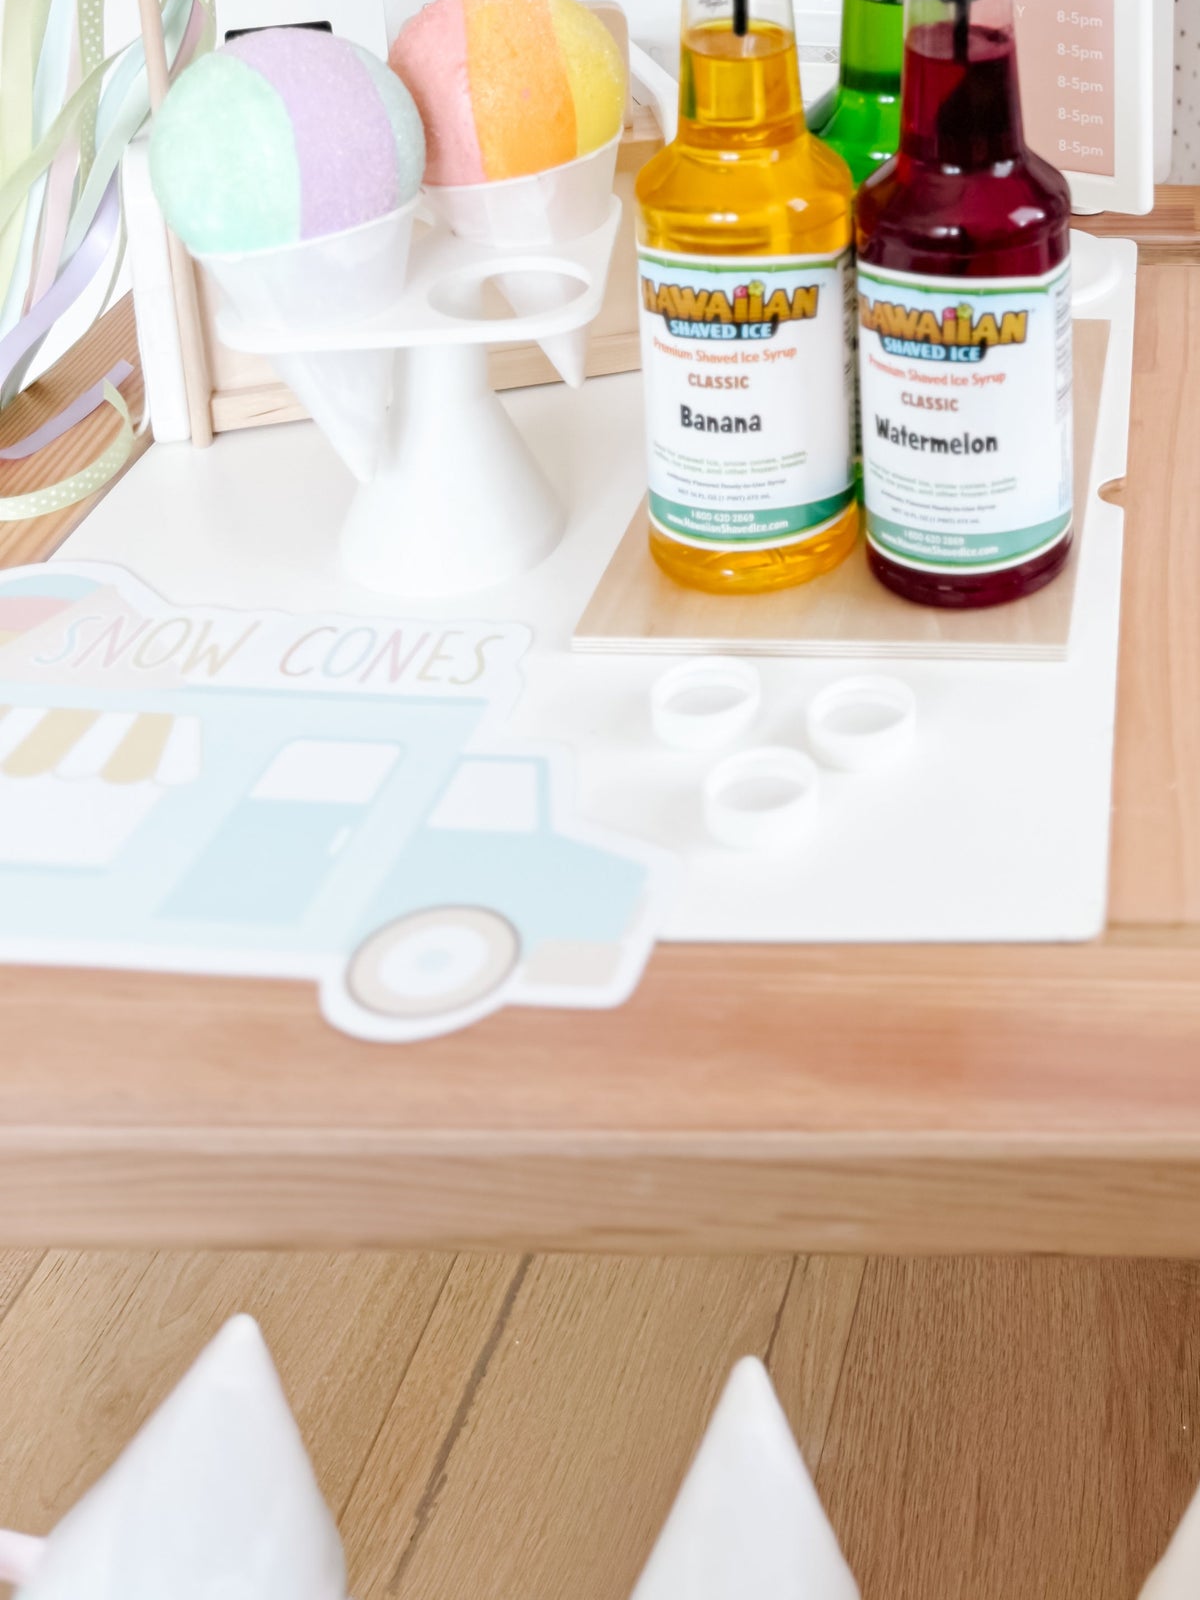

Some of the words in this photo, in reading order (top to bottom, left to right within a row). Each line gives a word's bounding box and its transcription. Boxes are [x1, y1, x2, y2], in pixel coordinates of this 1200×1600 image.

[1056, 11, 1103, 27] 8-5pm
[1056, 44, 1103, 60] 8-5pm
[1056, 76, 1103, 92] 8-5pm
[1056, 108, 1103, 125] 8-5pm
[1056, 140, 1103, 157] 8-5pm
[641, 275, 820, 324] HAWAIIAN
[671, 320, 737, 339] SHAVED
[742, 323, 772, 339] ICE
[653, 336, 692, 360] Premium
[697, 351, 737, 363] Shaved
[742, 351, 759, 363] Ice
[763, 346, 797, 364] Syrup
[884, 337, 946, 360] SHAVED
[950, 346, 980, 361] ICE
[688, 373, 749, 389] CLASSIC
[909, 368, 947, 386] Shaved
[951, 374, 968, 386] Ice
[972, 373, 1006, 388] Syrup
[901, 391, 959, 412] CLASSIC
[680, 404, 762, 433] Banana
[875, 413, 998, 455] Watermelon
[33, 613, 261, 676] SNOW
[280, 625, 505, 686] CONES
